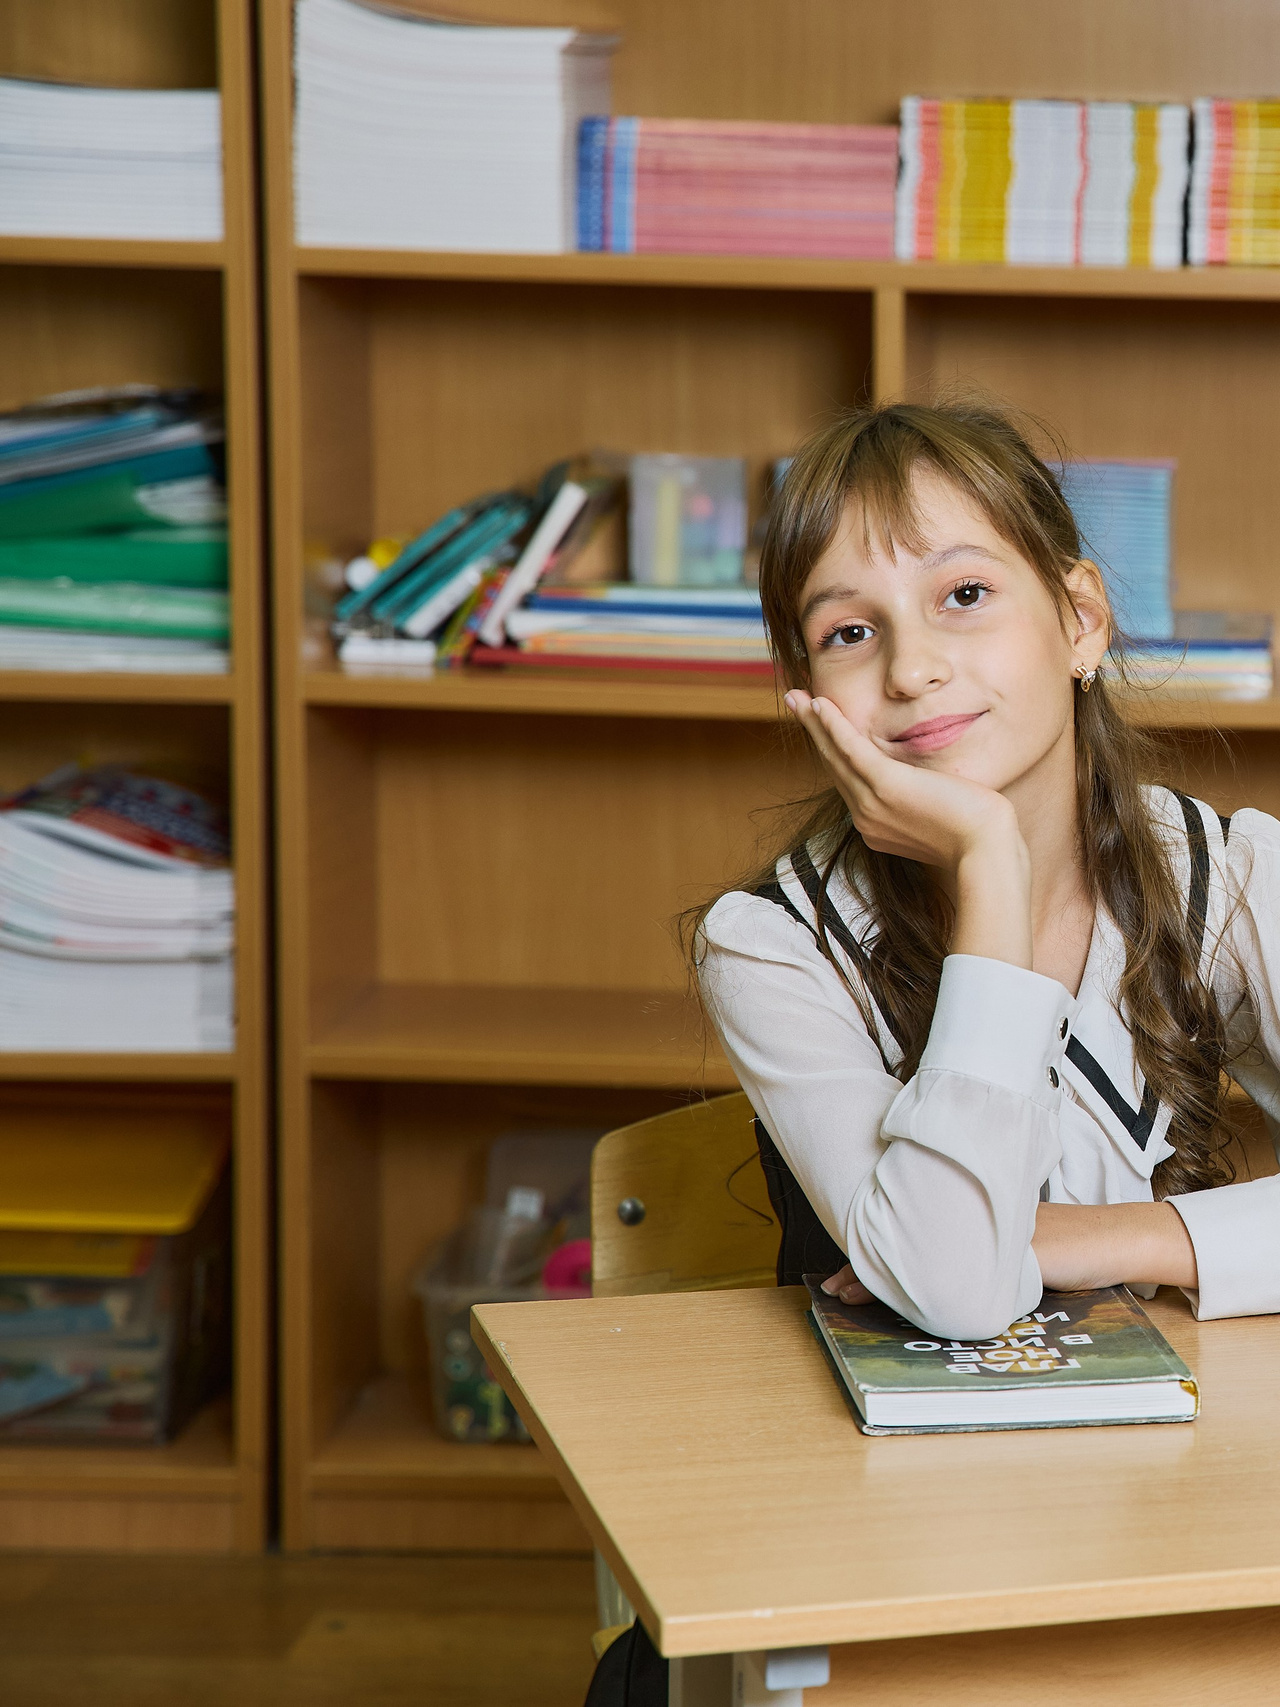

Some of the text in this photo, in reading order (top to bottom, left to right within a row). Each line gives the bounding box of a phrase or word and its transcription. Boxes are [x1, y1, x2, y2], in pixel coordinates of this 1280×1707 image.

[903, 1333, 1094, 1352] В ИСТО
[949, 1347, 1062, 1363] НОЕ
[946, 1358, 1081, 1374] ГЛАВ
